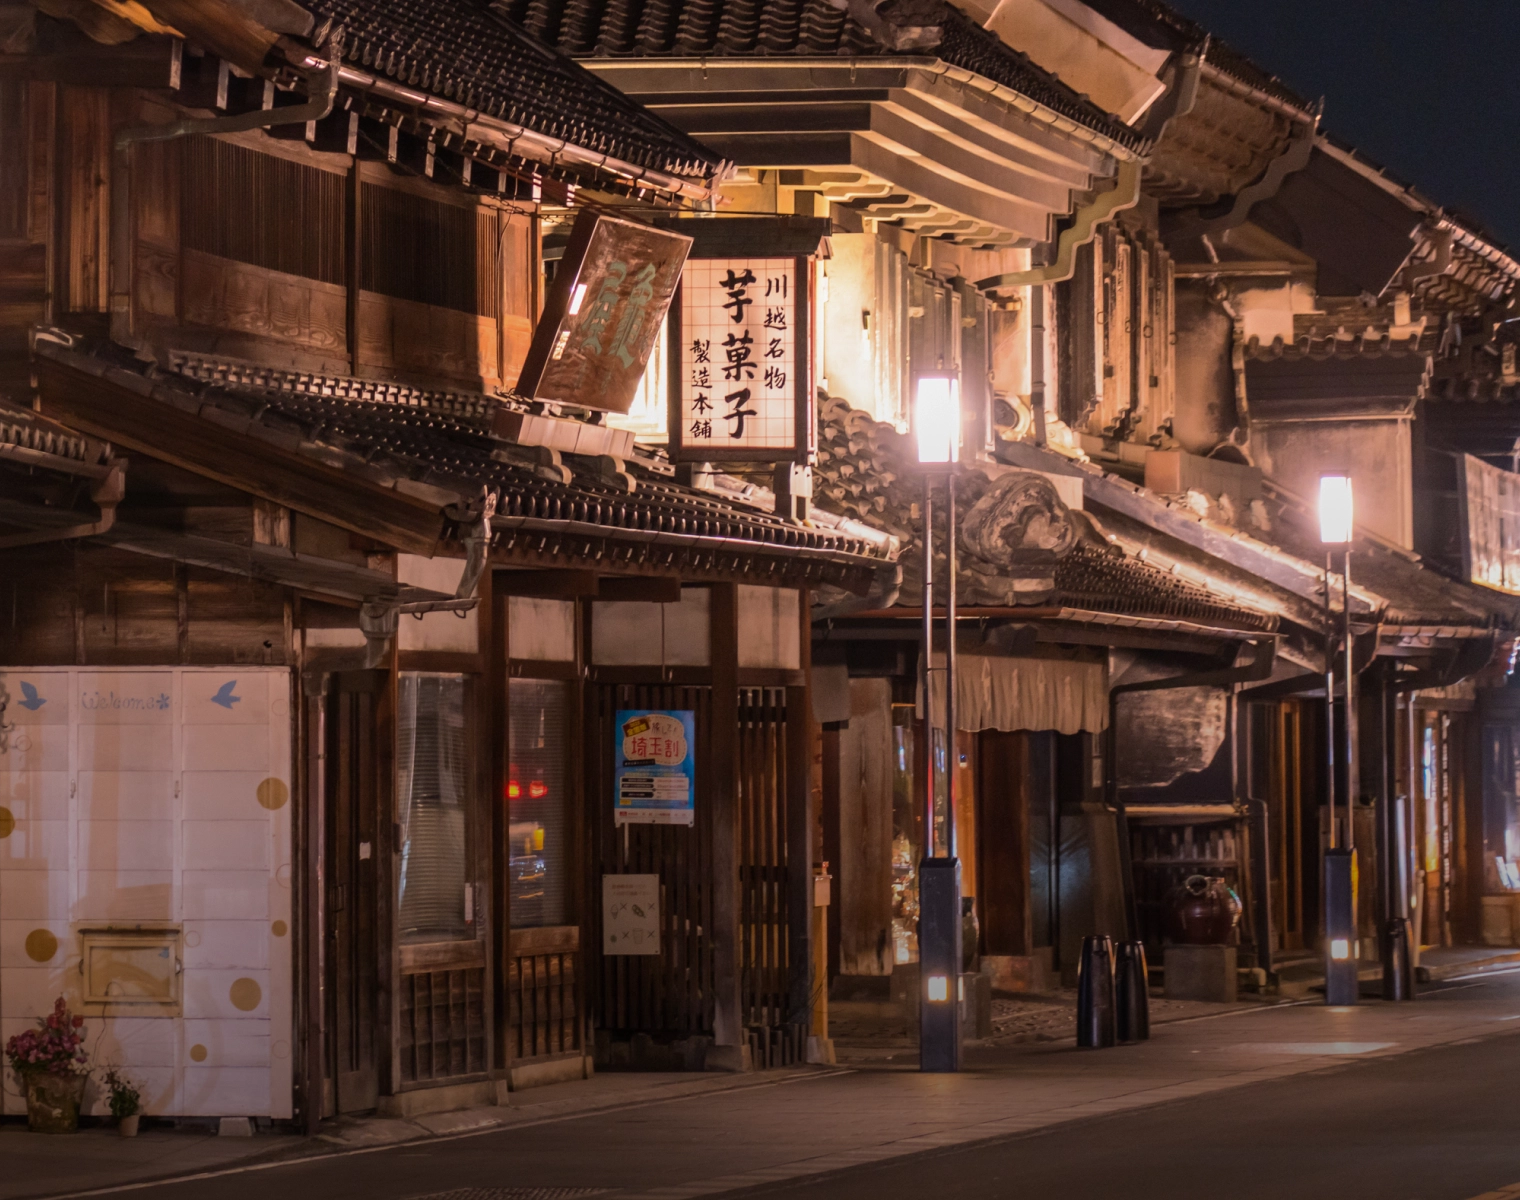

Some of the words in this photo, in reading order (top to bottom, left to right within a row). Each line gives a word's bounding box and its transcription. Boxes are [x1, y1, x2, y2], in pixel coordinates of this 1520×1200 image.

[719, 269, 758, 440] 芋菓子
[764, 274, 788, 390] 川越名物
[689, 339, 714, 440] 製造本舗
[82, 691, 155, 710] Welcome
[631, 737, 679, 758] 埼玉割
